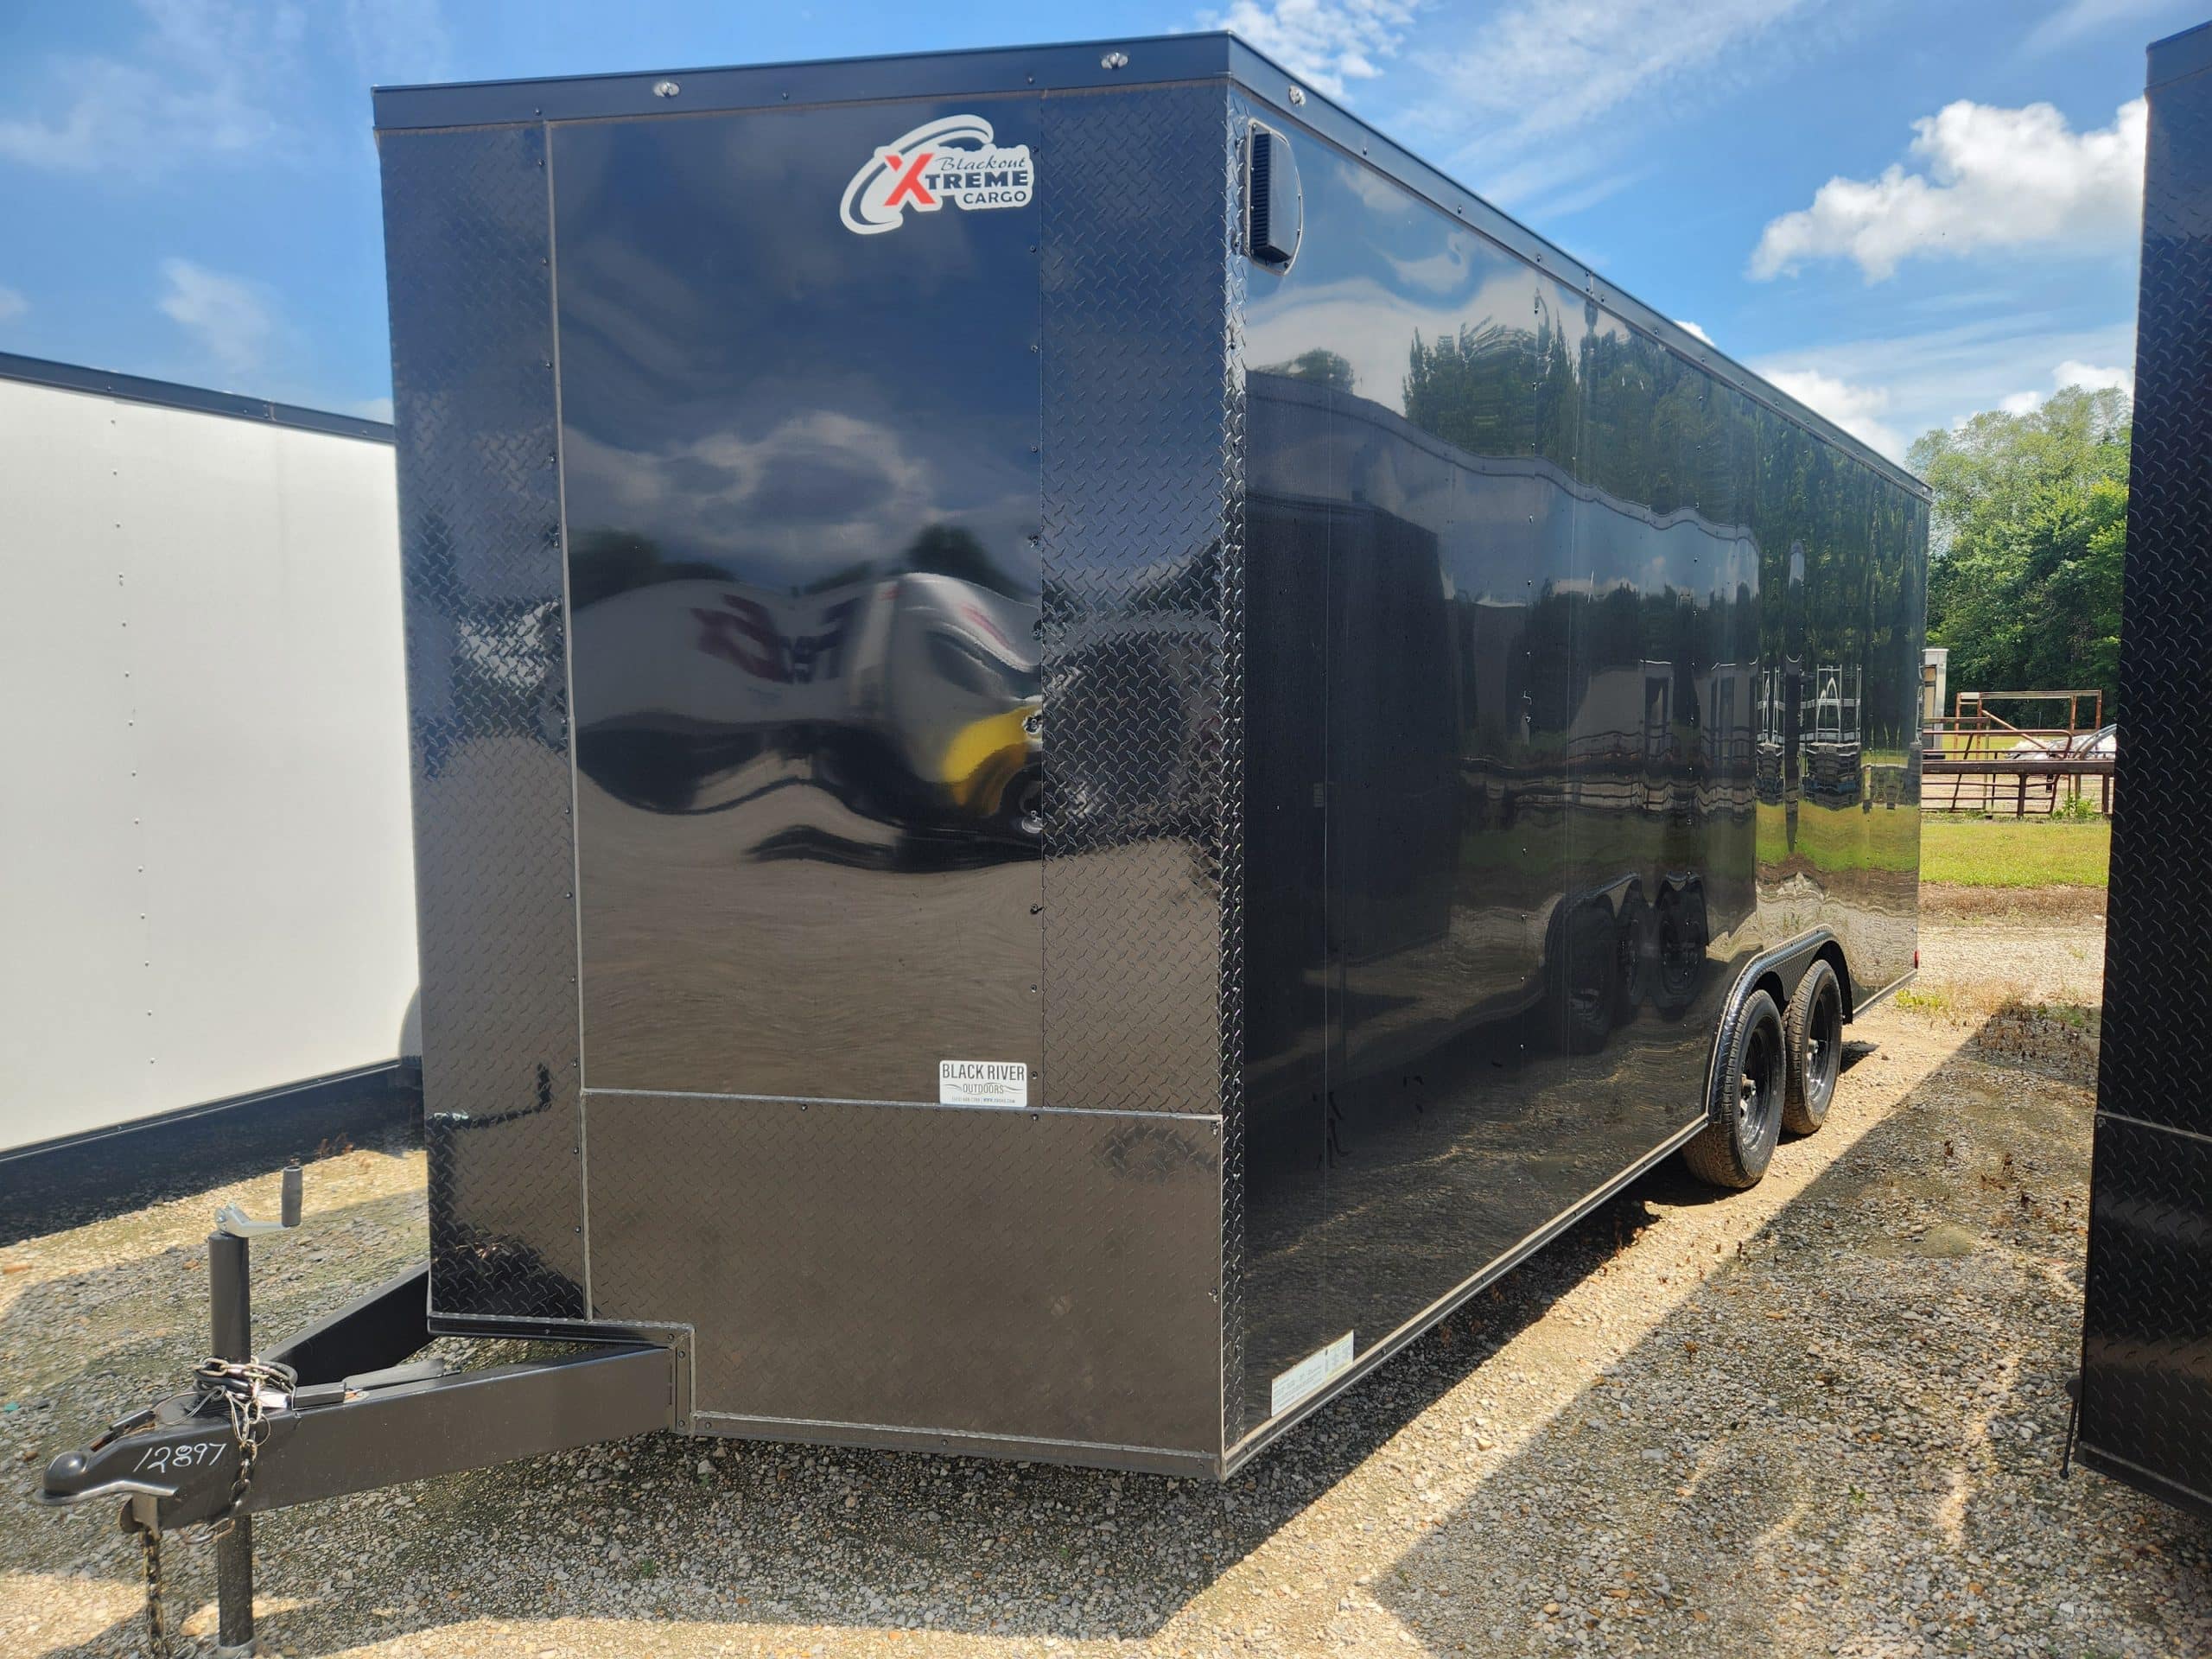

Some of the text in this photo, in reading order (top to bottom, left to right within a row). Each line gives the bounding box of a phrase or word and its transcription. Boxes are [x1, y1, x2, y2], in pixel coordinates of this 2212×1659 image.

[937, 155, 1026, 172] Blackout
[963, 190, 1027, 205] CARGO
[942, 1064, 1025, 1081] BLACK RIVER
[963, 1084, 1004, 1094] OUTDOORS
[132, 1443, 226, 1473] 12897
